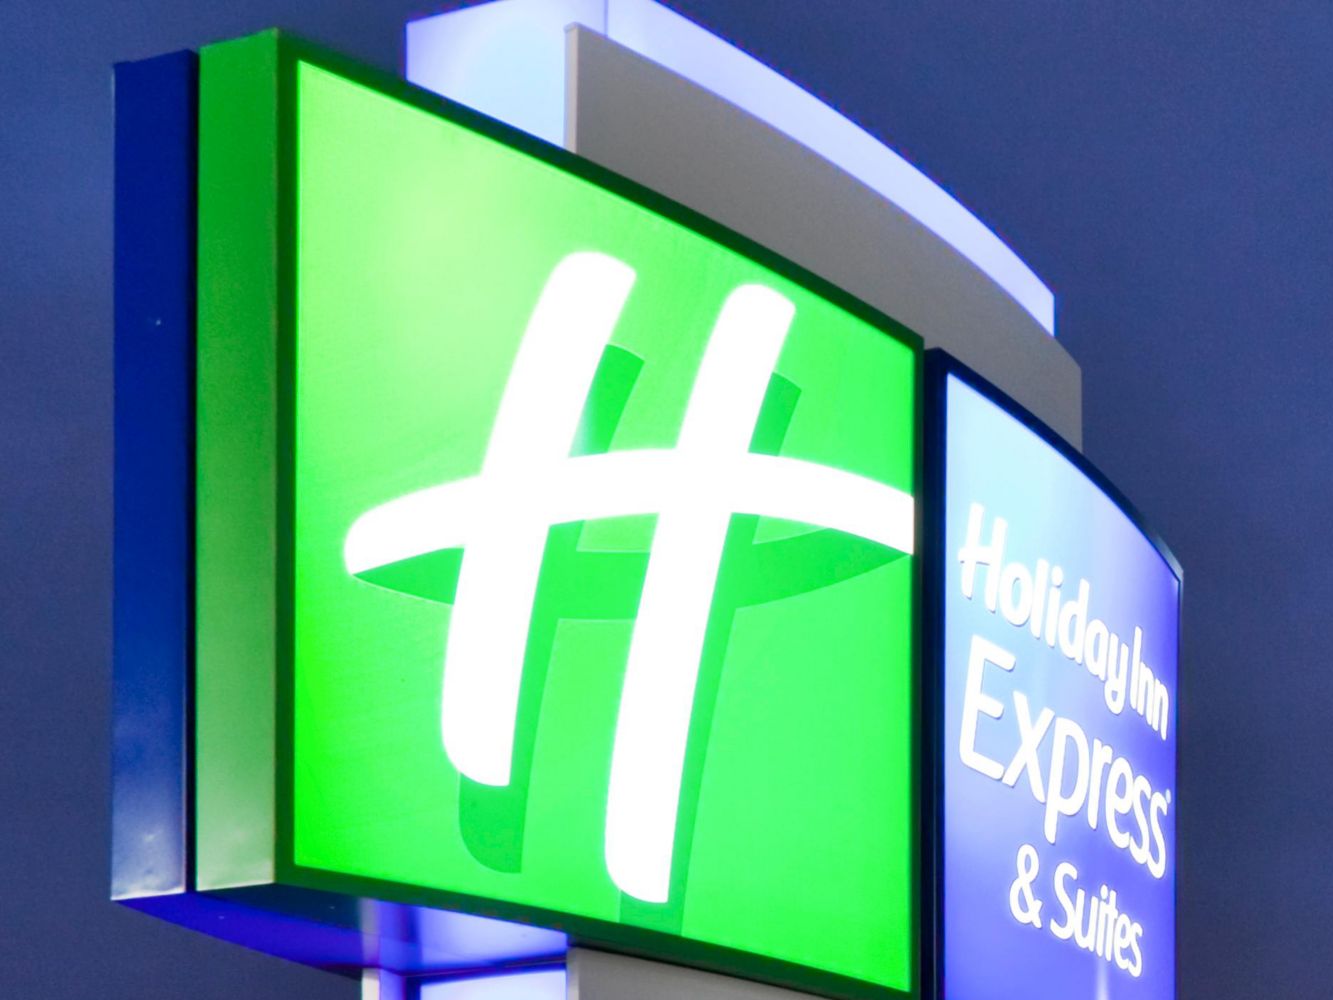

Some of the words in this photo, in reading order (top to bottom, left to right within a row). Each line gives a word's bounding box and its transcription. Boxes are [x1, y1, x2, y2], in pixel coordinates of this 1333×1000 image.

[957, 502, 1128, 716] Holiday
[1129, 625, 1169, 742] Inn
[959, 633, 1170, 880] Express
[1009, 843, 1043, 930] &
[1049, 860, 1143, 979] Suites
